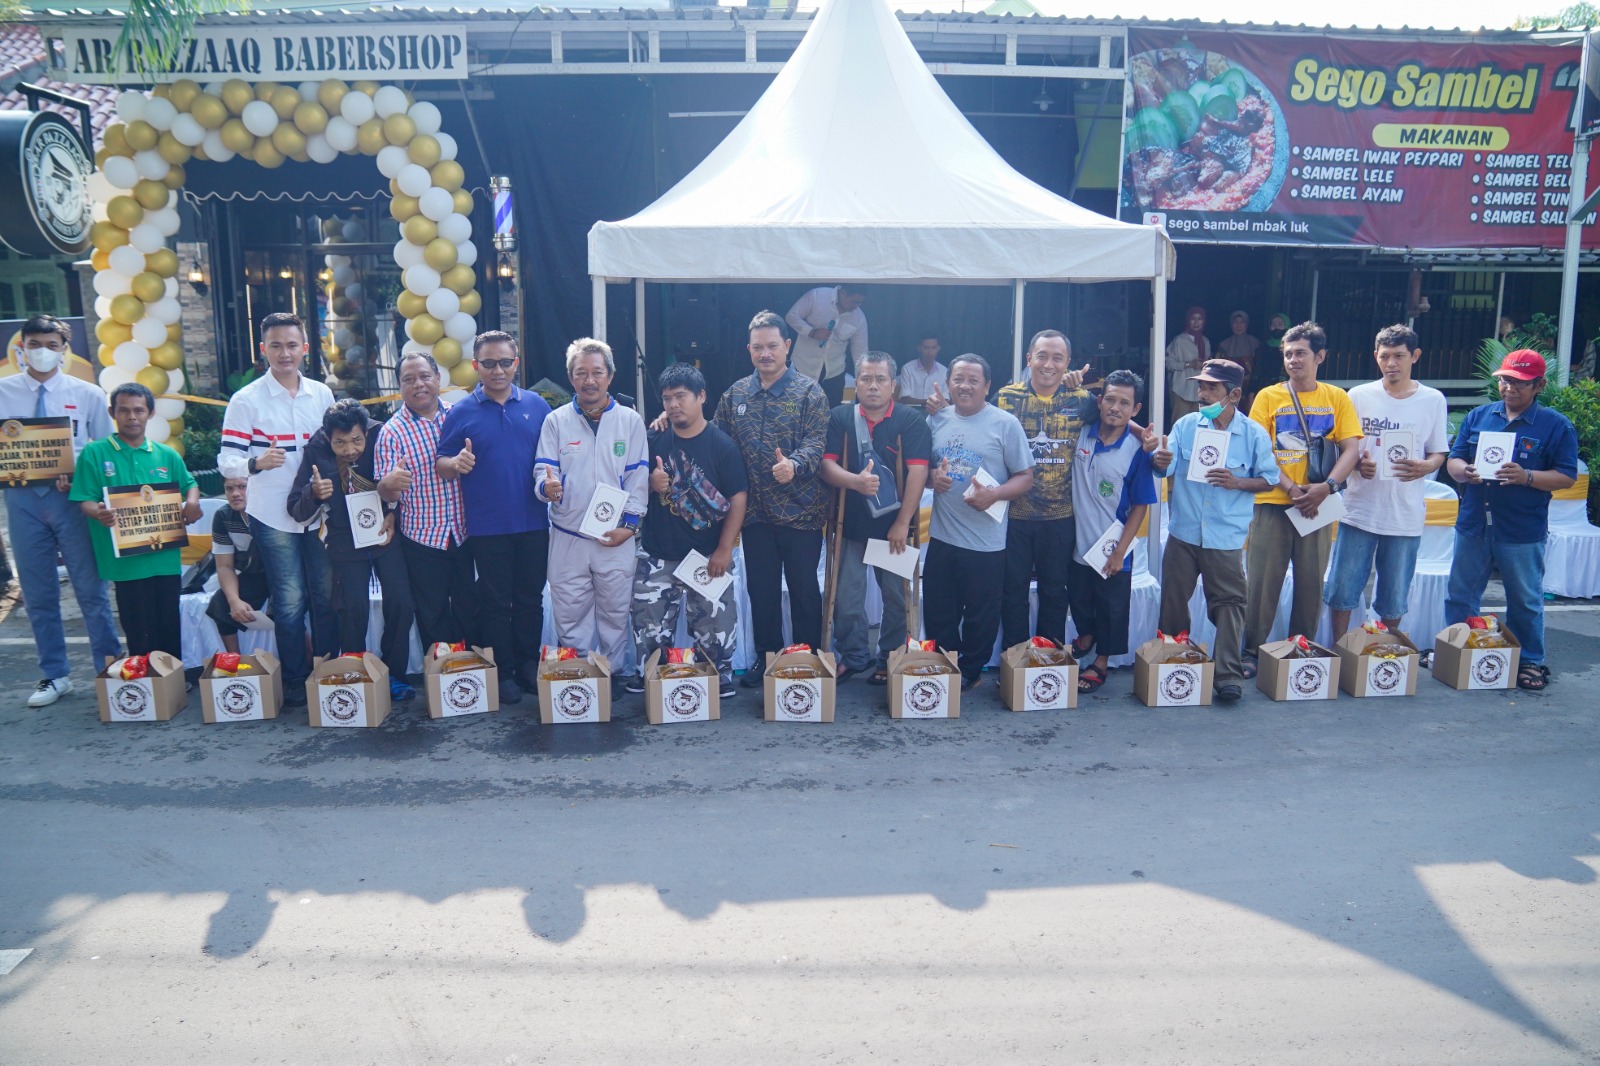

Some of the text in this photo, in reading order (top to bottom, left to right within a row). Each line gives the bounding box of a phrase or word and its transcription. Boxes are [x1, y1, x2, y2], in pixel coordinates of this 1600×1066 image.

[273, 34, 462, 71] BABERSHOP
[1290, 58, 1387, 109] Sego
[1392, 64, 1538, 109] Sambel
[1400, 128, 1493, 146] MAKANAN
[1302, 146, 1464, 167] SAMBEL IWAK PE/PARI
[1485, 153, 1541, 168] SAMBEL
[1301, 167, 1394, 184] SAMBEL LELE
[1484, 172, 1540, 187] SAMBEL
[1301, 185, 1403, 202] SAMBEL AYAM
[1483, 191, 1538, 206] SAMBEL
[1482, 209, 1597, 225] SAMBEL SALN
[1168, 219, 1309, 233] sego sambel mbak luk
[118, 515, 142, 528] SETIAP
[143, 513, 160, 526] HARI
